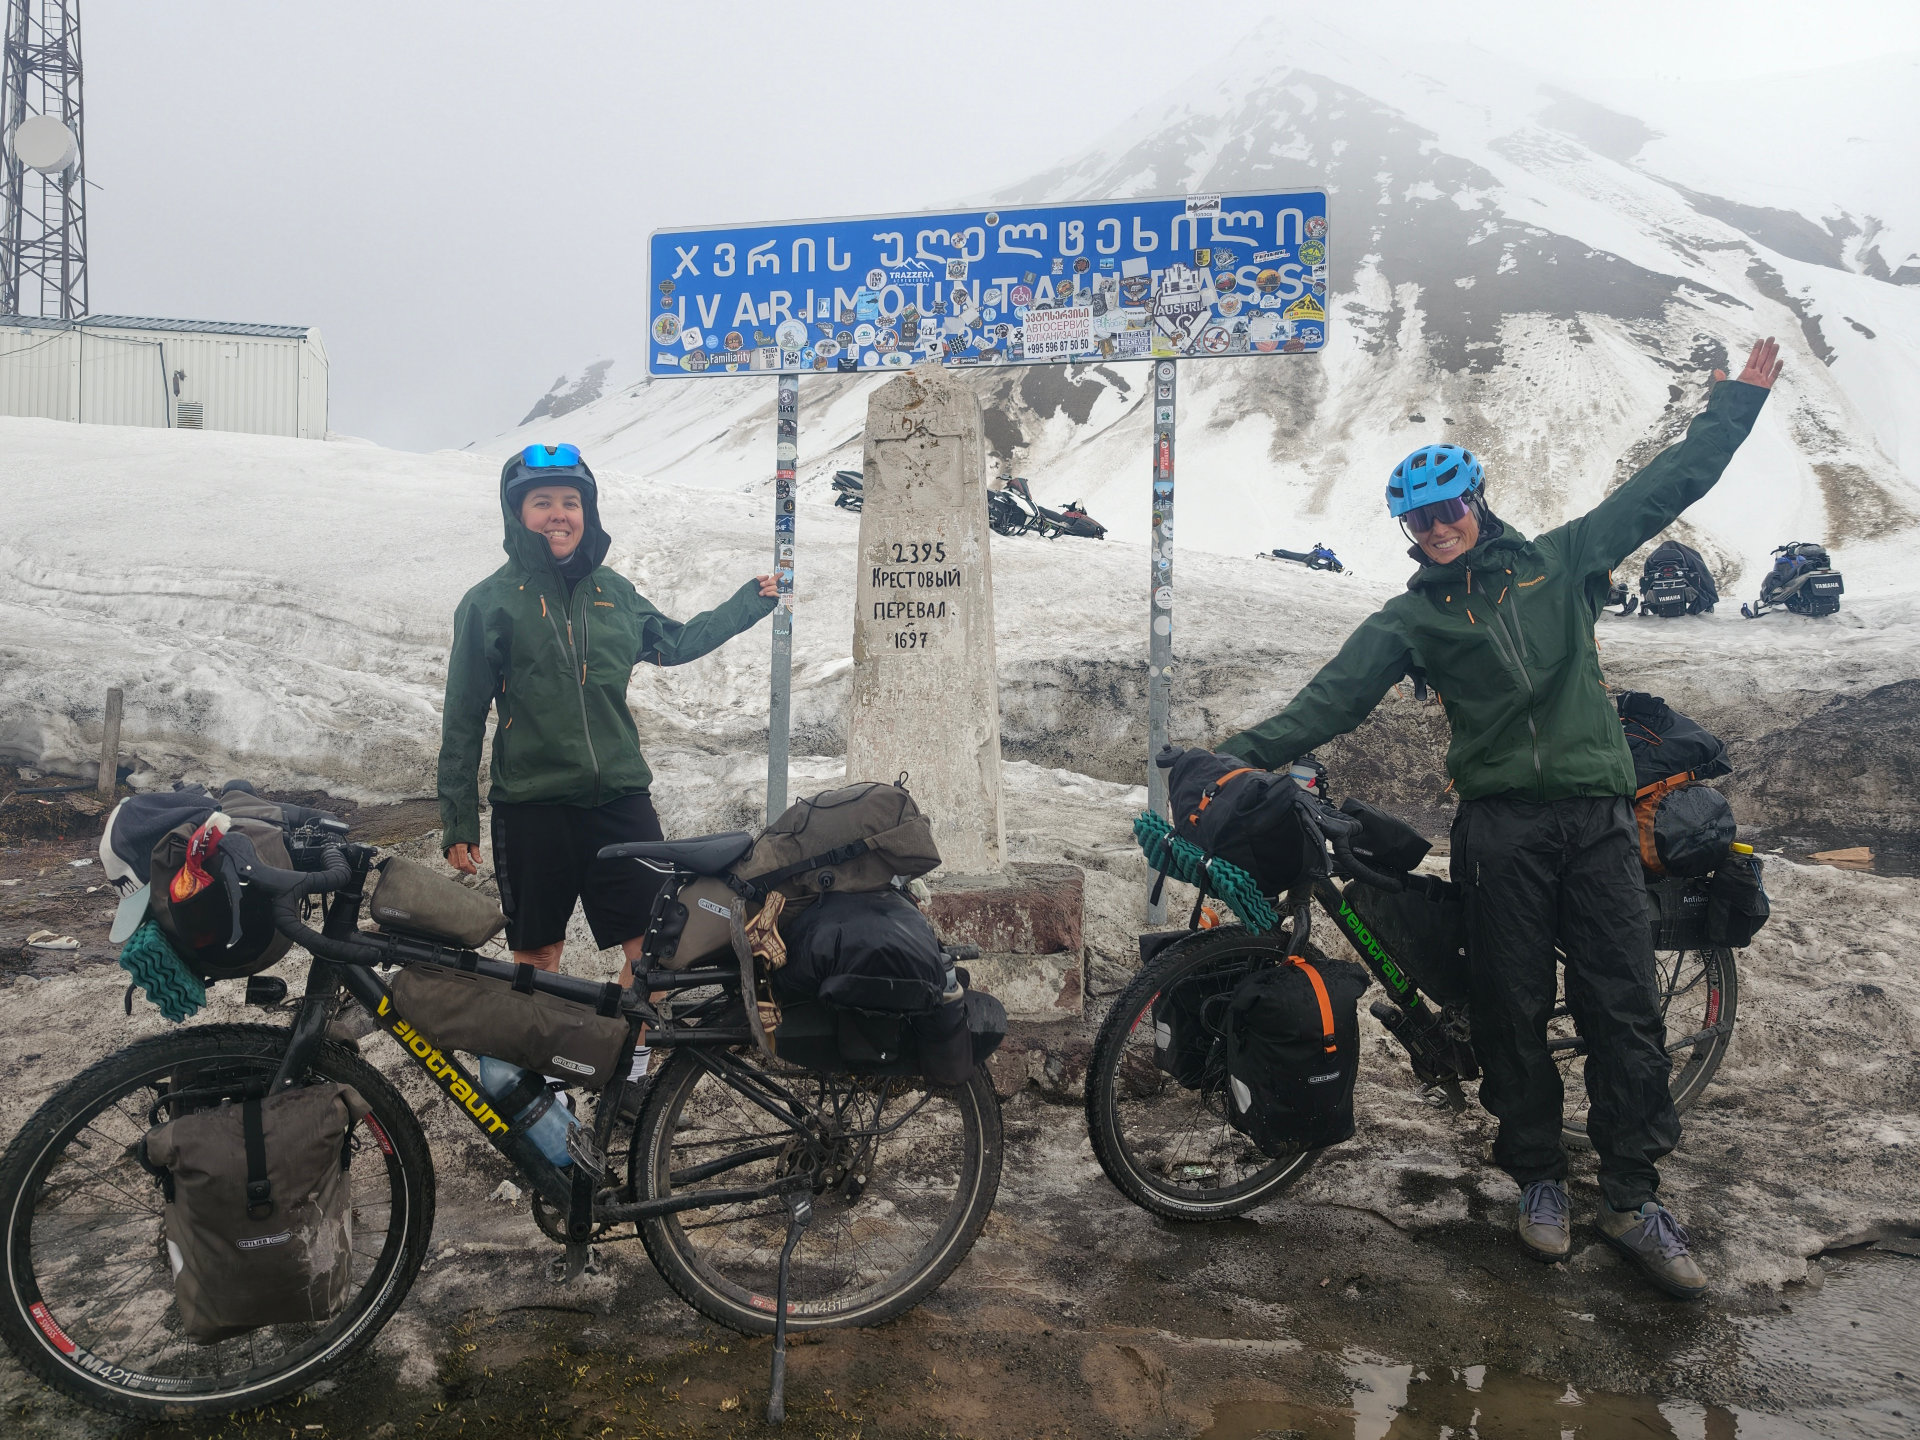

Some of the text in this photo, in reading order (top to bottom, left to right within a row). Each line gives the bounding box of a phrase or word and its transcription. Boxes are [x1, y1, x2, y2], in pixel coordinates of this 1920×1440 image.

[672, 236, 851, 280] ჯვრის
[872, 207, 1304, 267] უღელტეხილი
[889, 271, 935, 279] TRAZZERA
[1012, 293, 1029, 302] FCN
[1025, 318, 1090, 333] АВТОСЕРВИС
[1026, 329, 1089, 343] ВУЛКАНИЗАЦИЯ
[1027, 338, 1089, 354] +995 596 87 50 50
[709, 351, 751, 365] Familiarity
[891, 541, 946, 564] 2395
[872, 567, 961, 588] КРЕСТОВЫЙ
[1814, 582, 1840, 590] YAMAHA
[1658, 594, 1681, 602] YAMAHA
[894, 631, 929, 649] 1697
[792, 1299, 842, 1314] XM481
[31, 1307, 58, 1340] DT SWISS
[325, 1277, 399, 1361] SCHWALBE MARATHON MONDIAL
[66, 1344, 133, 1386] XM421
